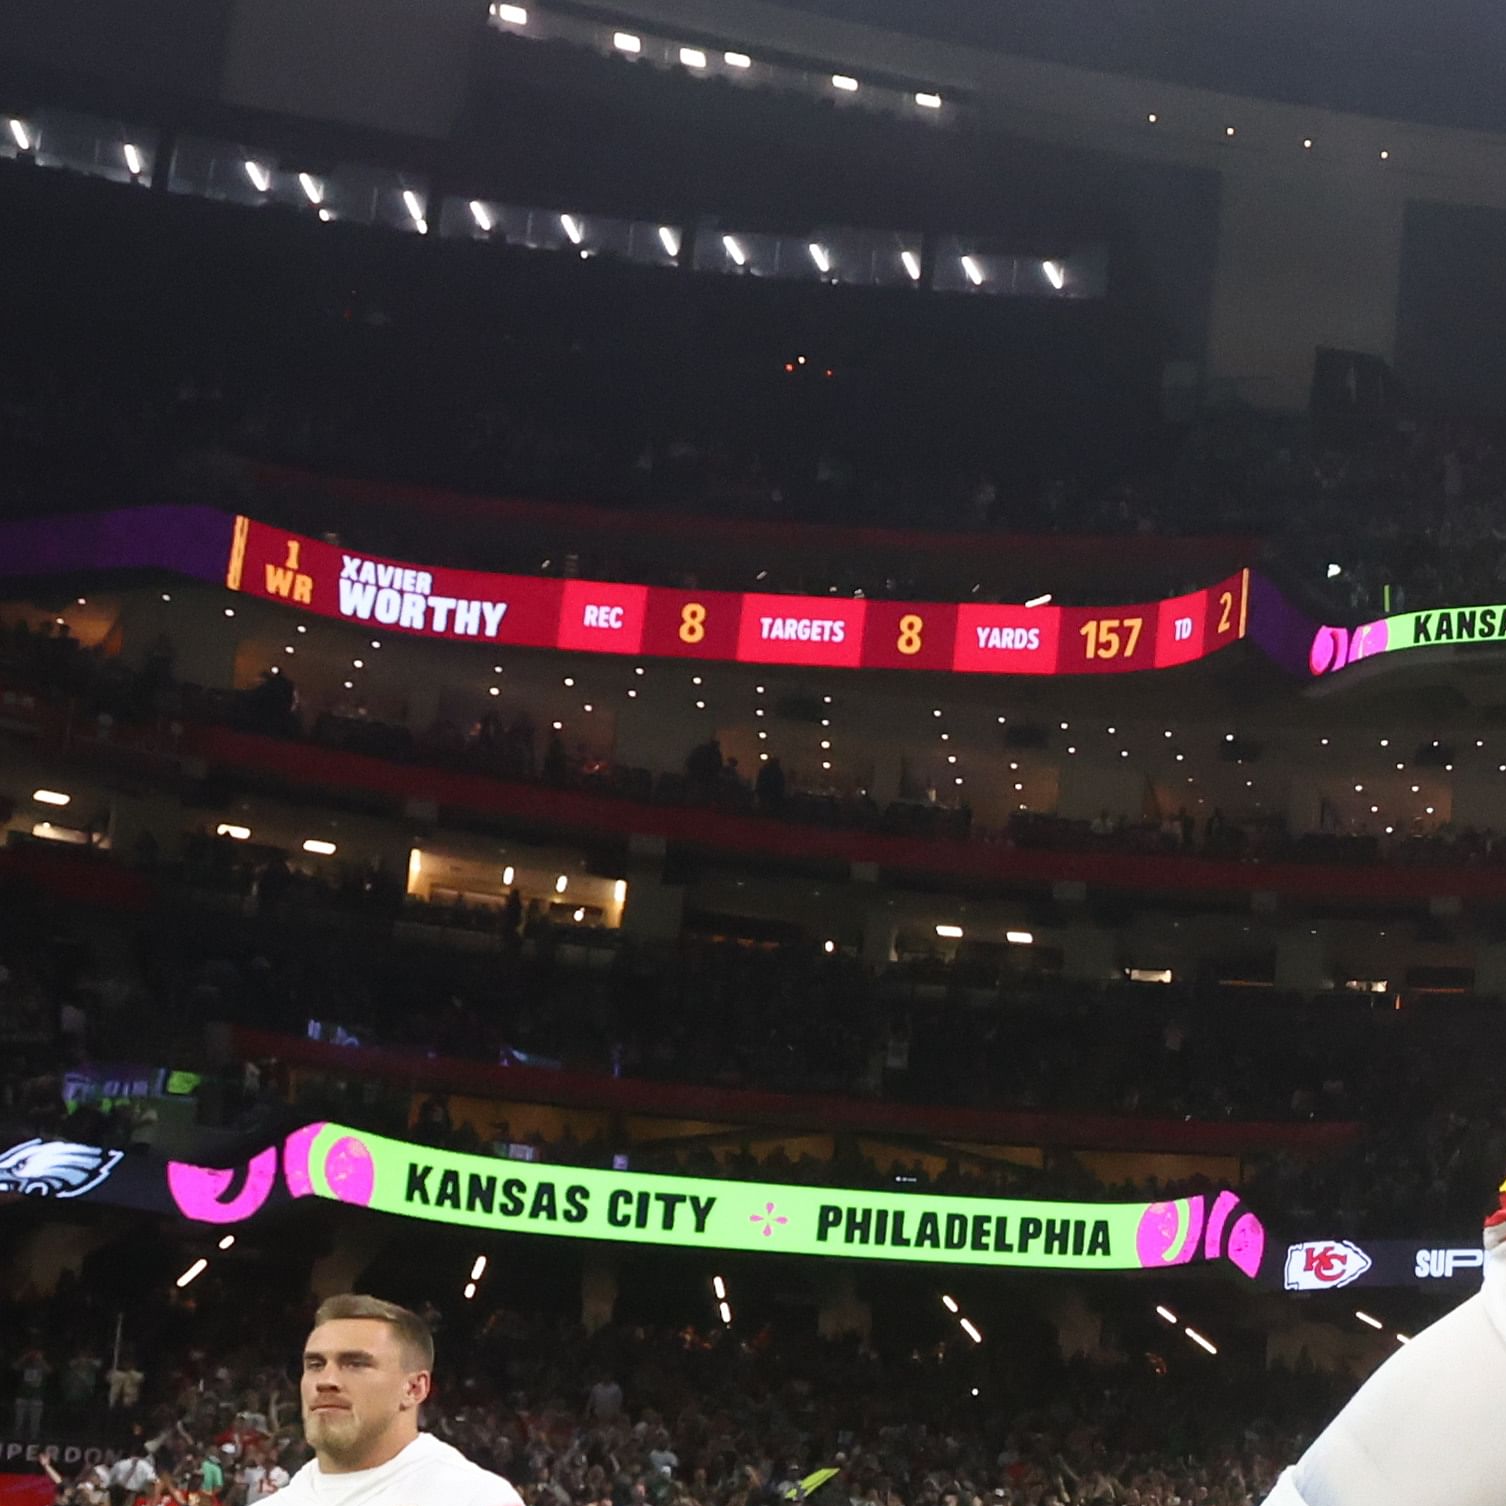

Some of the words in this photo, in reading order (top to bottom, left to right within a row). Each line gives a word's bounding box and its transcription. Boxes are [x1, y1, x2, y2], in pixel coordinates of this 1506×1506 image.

[286, 540, 300, 570] 1
[340, 555, 433, 595] XAVIER
[264, 563, 313, 604] WR
[338, 579, 507, 638] WORTHY
[583, 602, 624, 630] REC
[679, 603, 706, 644] 8
[760, 615, 845, 643] TARGETS
[896, 614, 923, 656] 8
[976, 625, 1040, 651] YARDS
[1080, 617, 1144, 661] 157
[1174, 616, 1193, 642] TD
[1217, 593, 1232, 632] 2
[405, 1162, 590, 1223] KANSAS
[607, 1189, 717, 1234] CITY
[817, 1204, 1112, 1258] PHILADELPHIA
